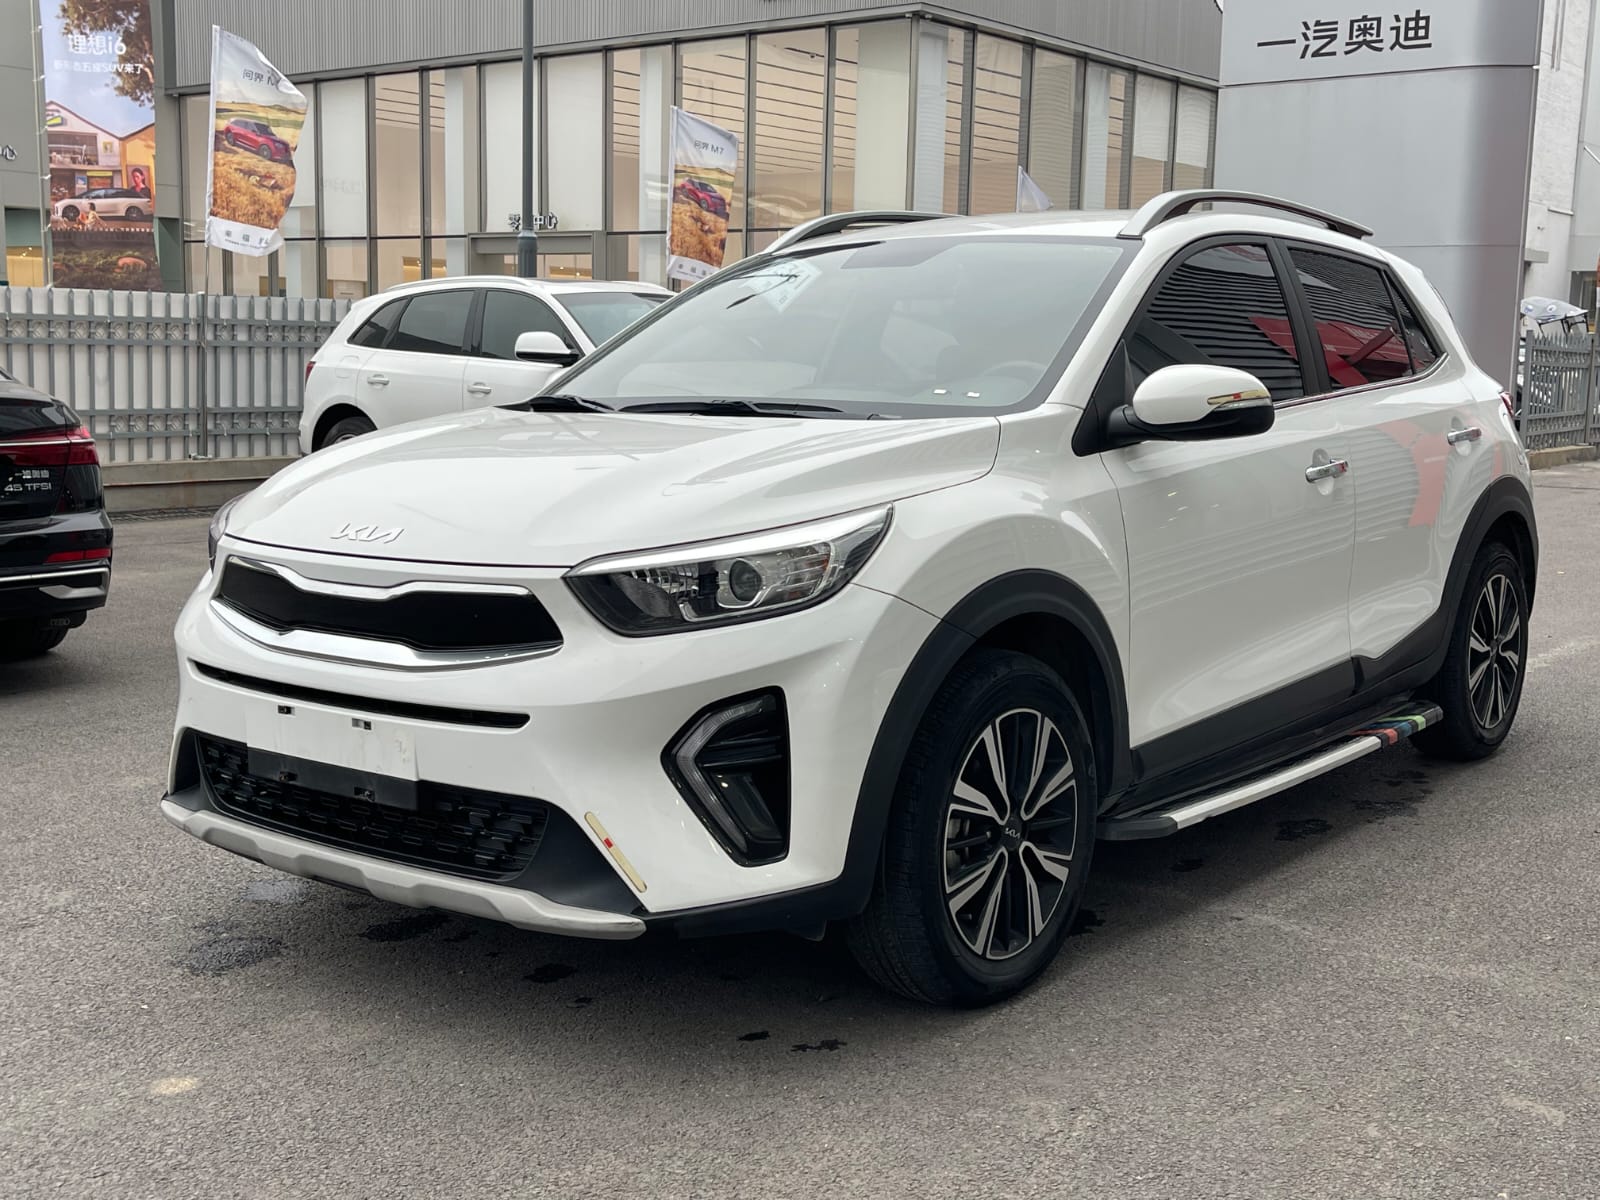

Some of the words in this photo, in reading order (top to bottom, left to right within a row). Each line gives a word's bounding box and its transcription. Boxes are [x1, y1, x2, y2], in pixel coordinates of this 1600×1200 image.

[68, 34, 127, 55] 理想i6
[1257, 9, 1432, 59] 一汽奥迪
[4, 483, 23, 491] 45
[24, 482, 52, 491] TFSI
